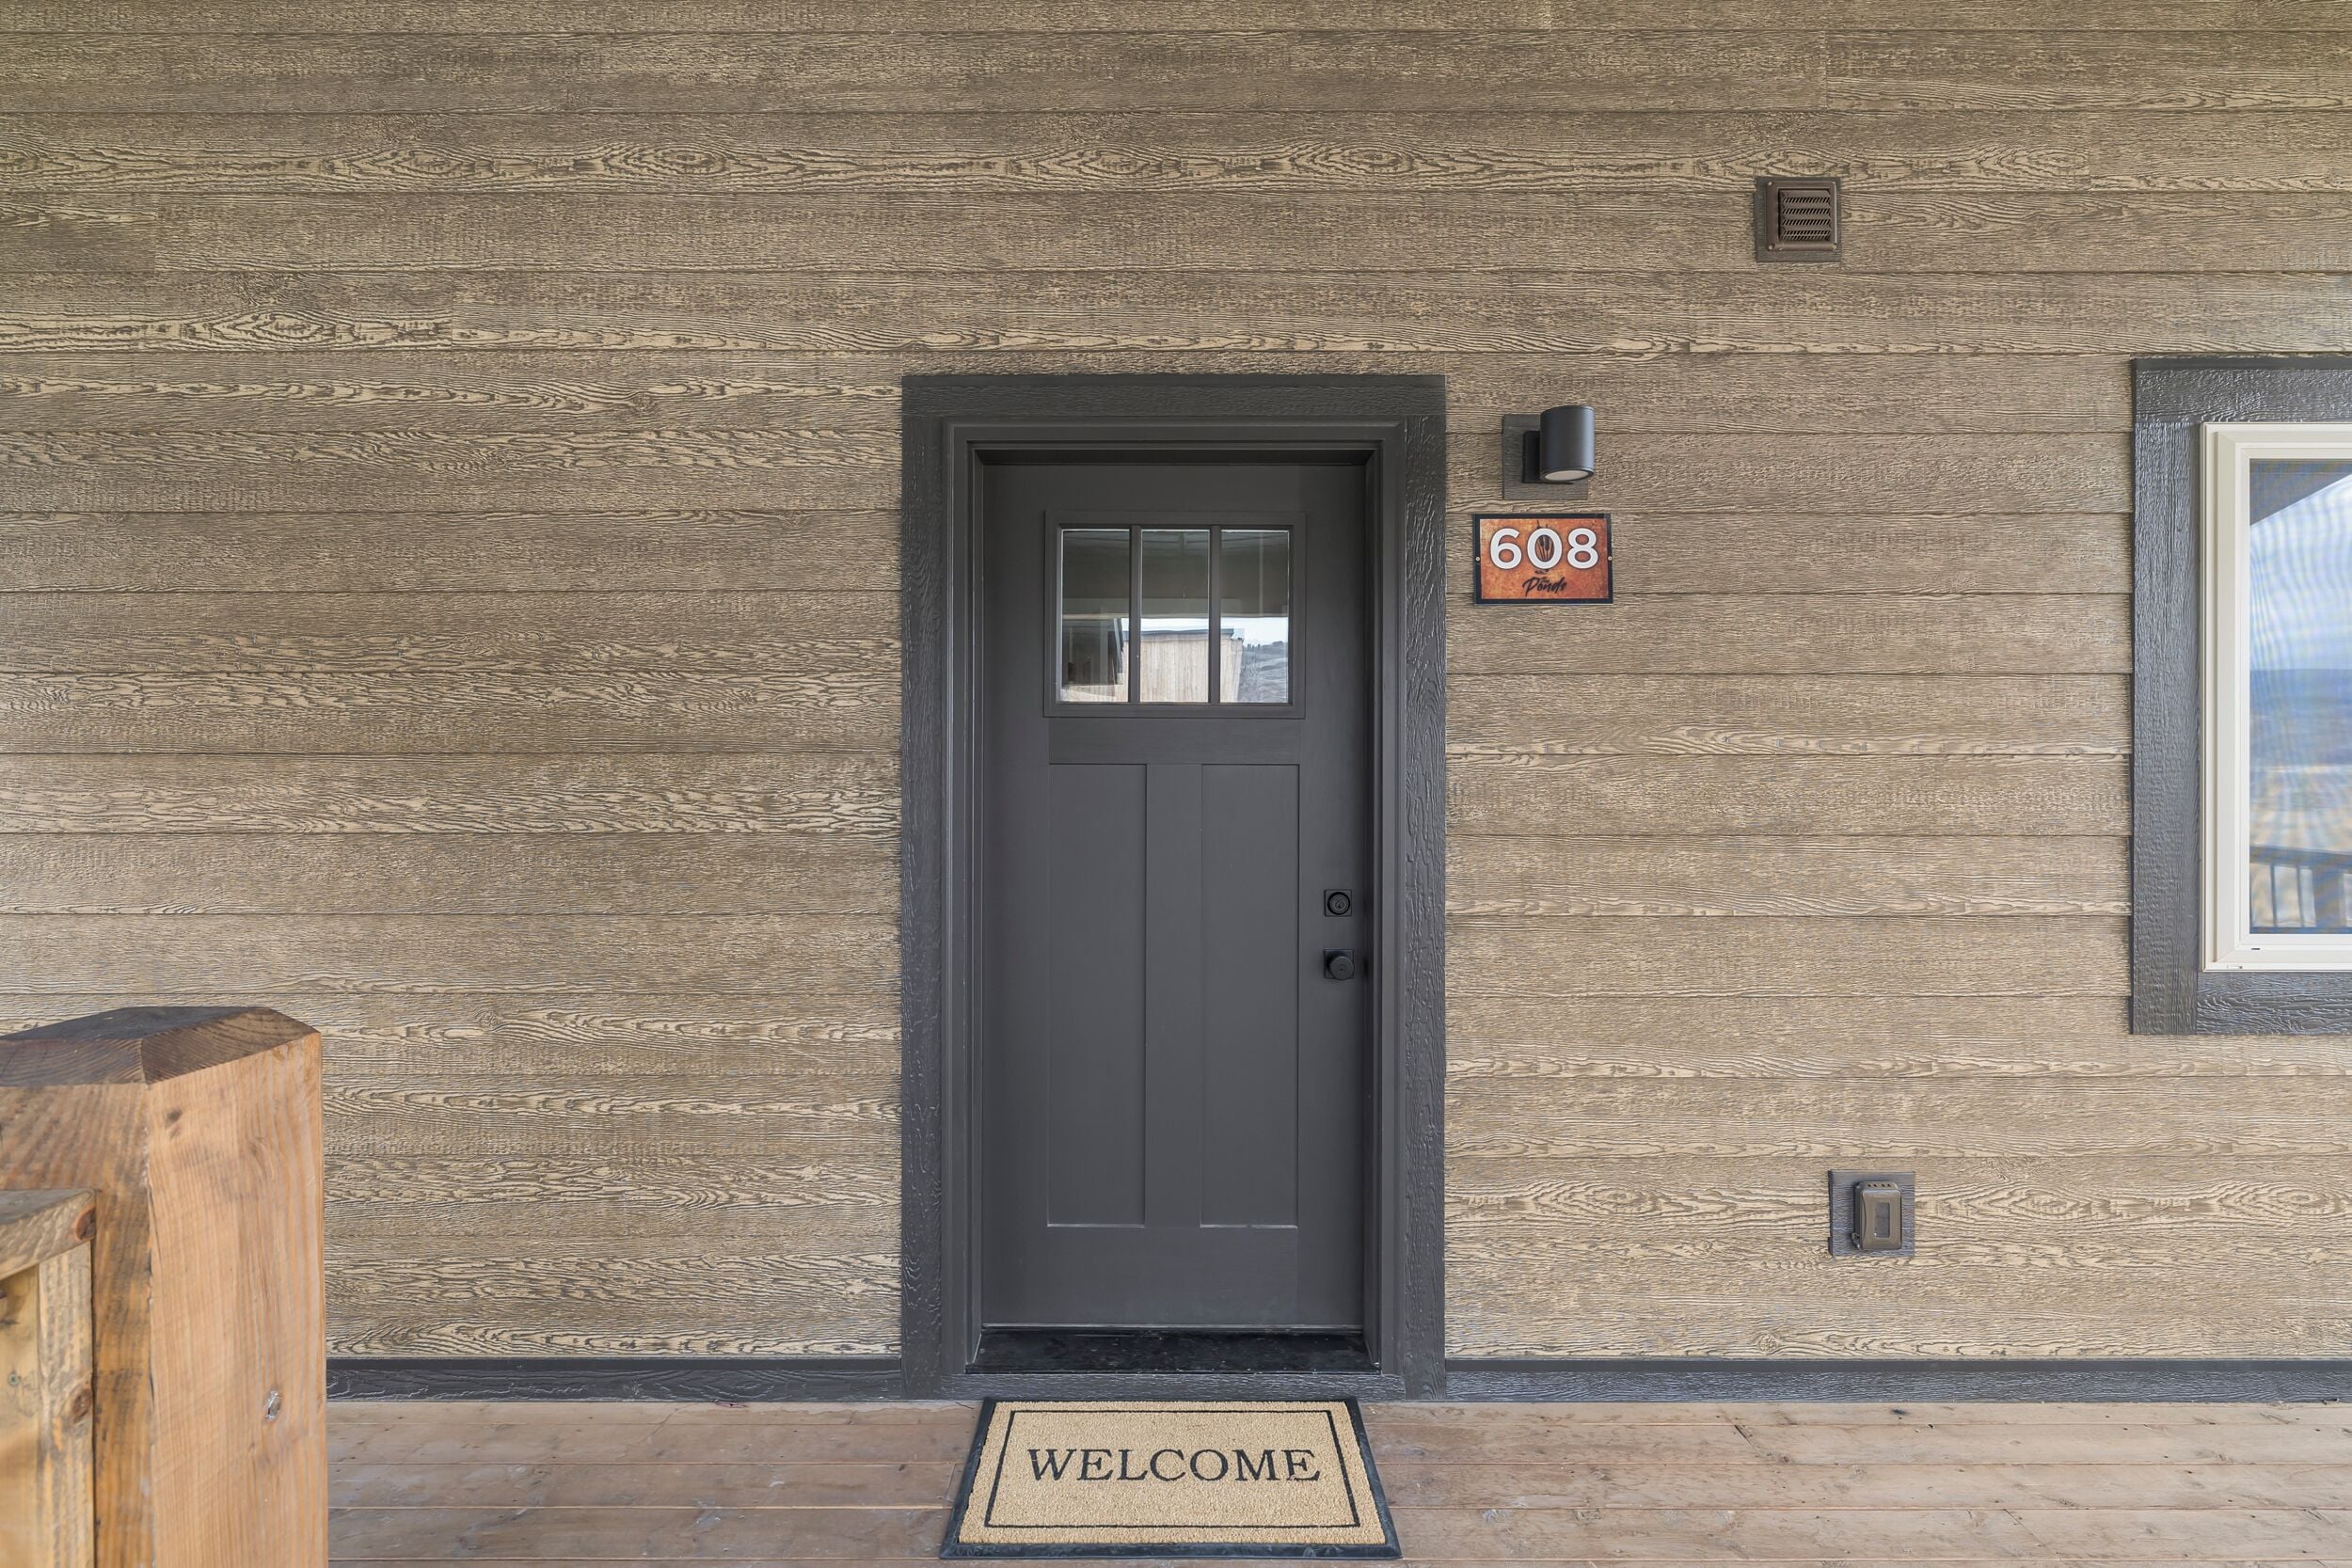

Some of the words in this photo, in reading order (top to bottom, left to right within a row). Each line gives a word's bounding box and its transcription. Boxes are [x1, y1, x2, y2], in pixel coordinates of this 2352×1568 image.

[1490, 528, 1598, 569] 608
[1522, 576, 1567, 597] Ponds
[1027, 1449, 1320, 1481] WELCOME
